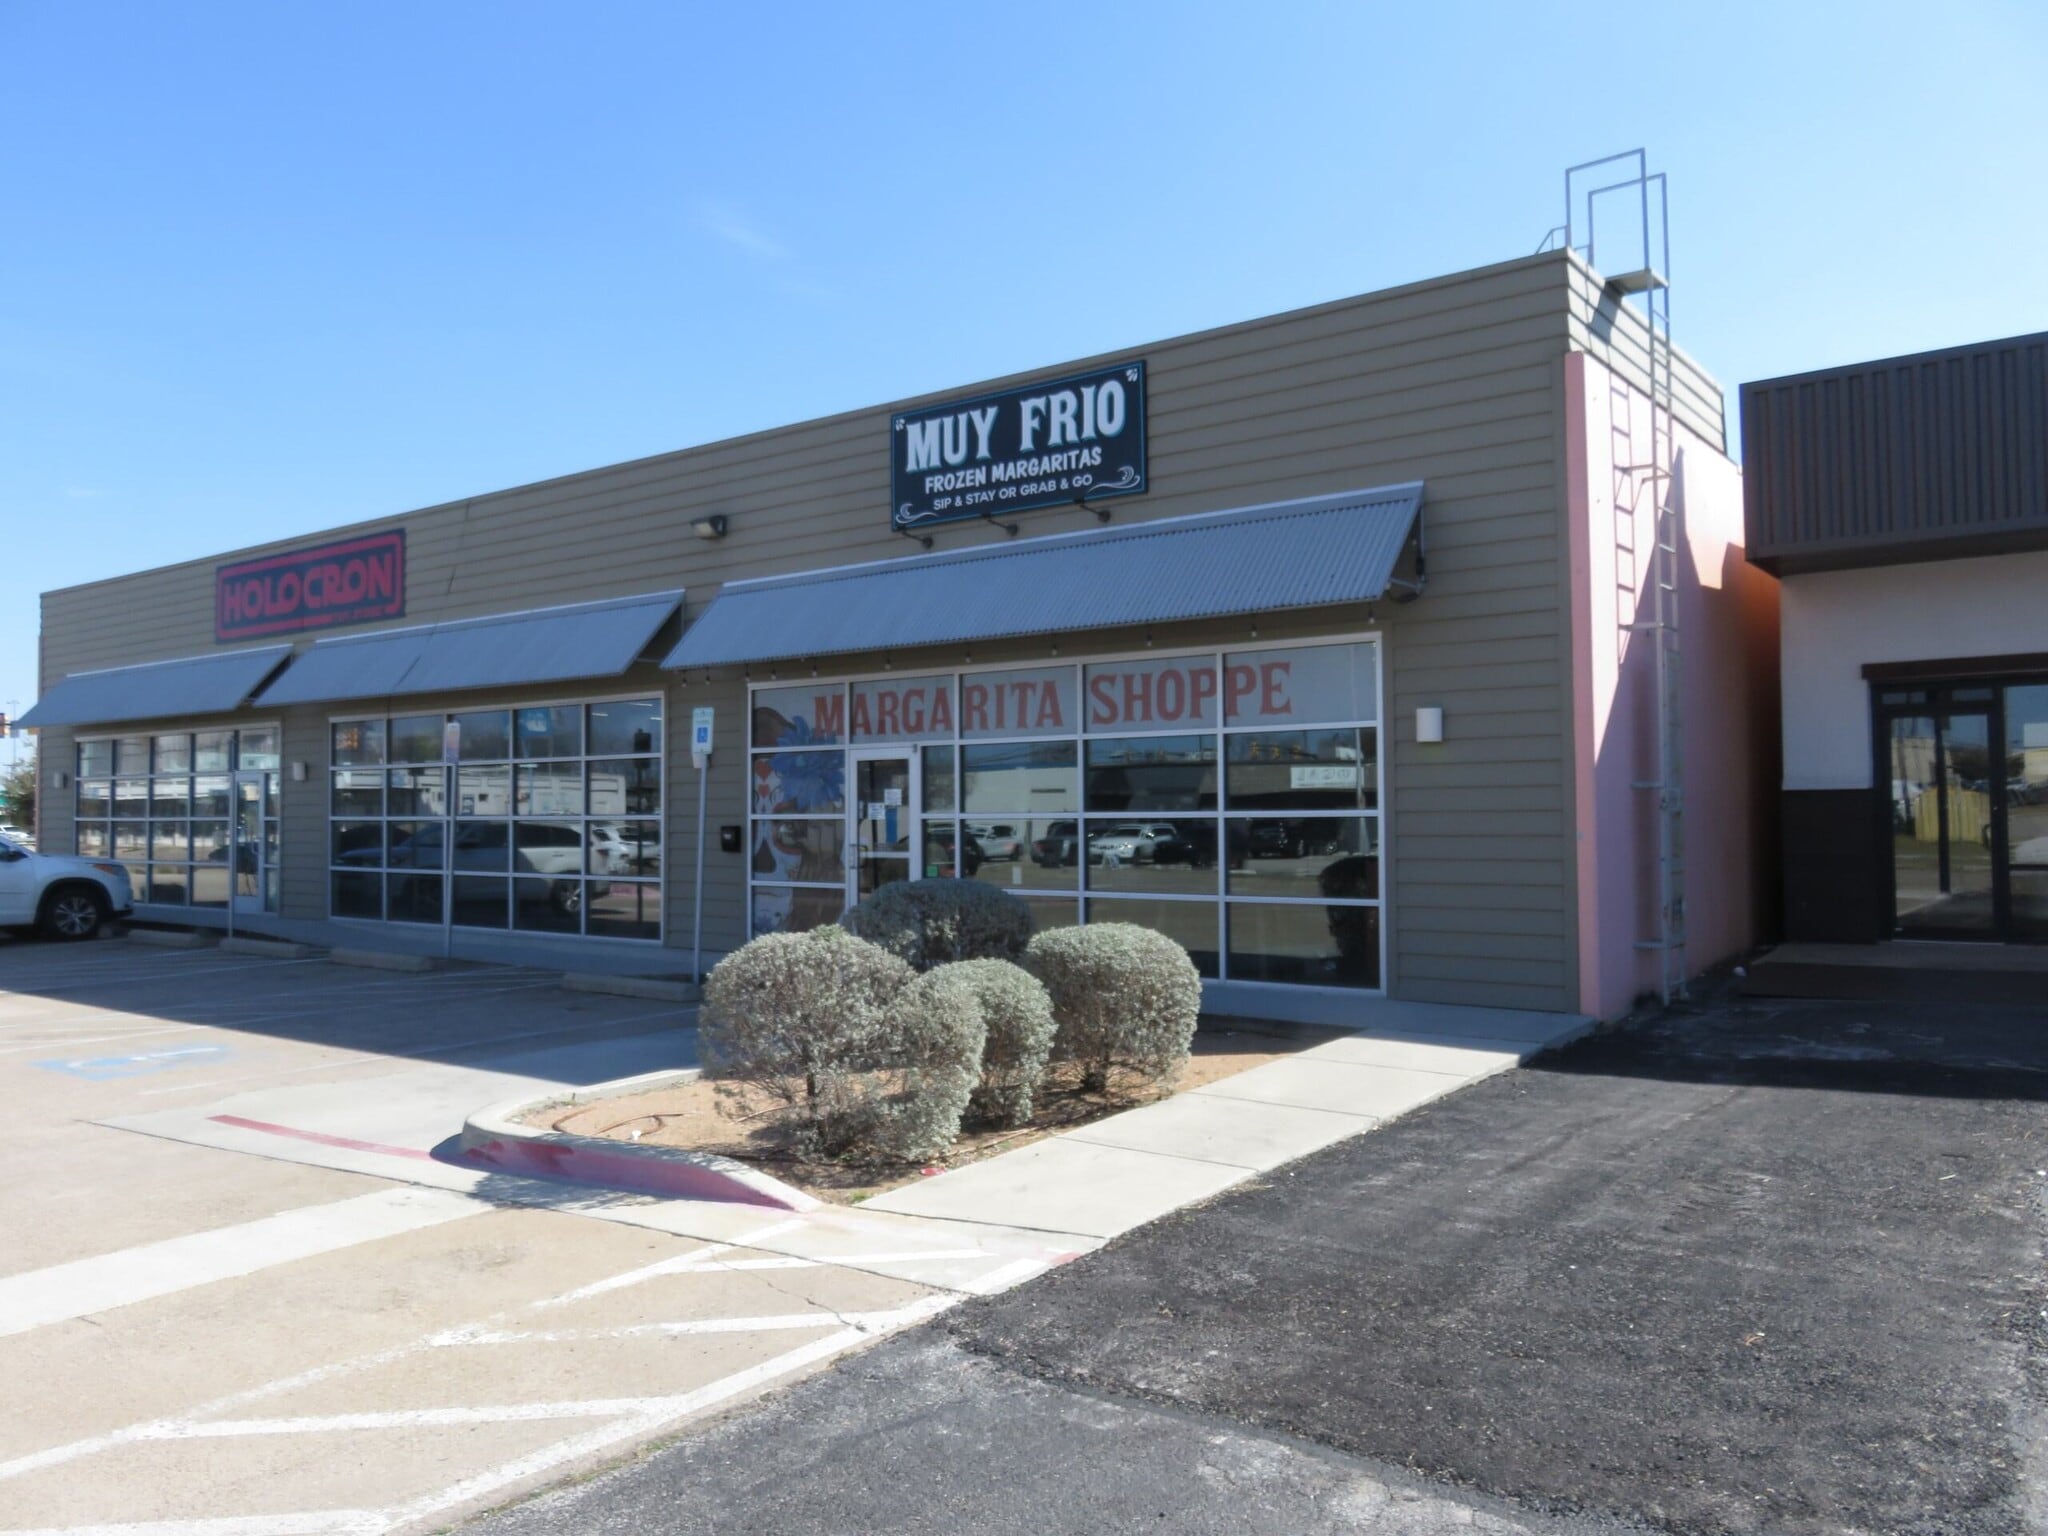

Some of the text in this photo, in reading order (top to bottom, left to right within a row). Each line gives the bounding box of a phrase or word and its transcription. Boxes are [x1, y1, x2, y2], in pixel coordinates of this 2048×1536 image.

[905, 379, 1126, 474] MUY FRIO
[925, 446, 1102, 495] FROZEN MARGARITAS
[933, 474, 1093, 511] SIP & STAY OR GRAB & GO
[223, 553, 393, 623] HOLOCRON
[813, 661, 1292, 738] MARGARITA SHOPPE
